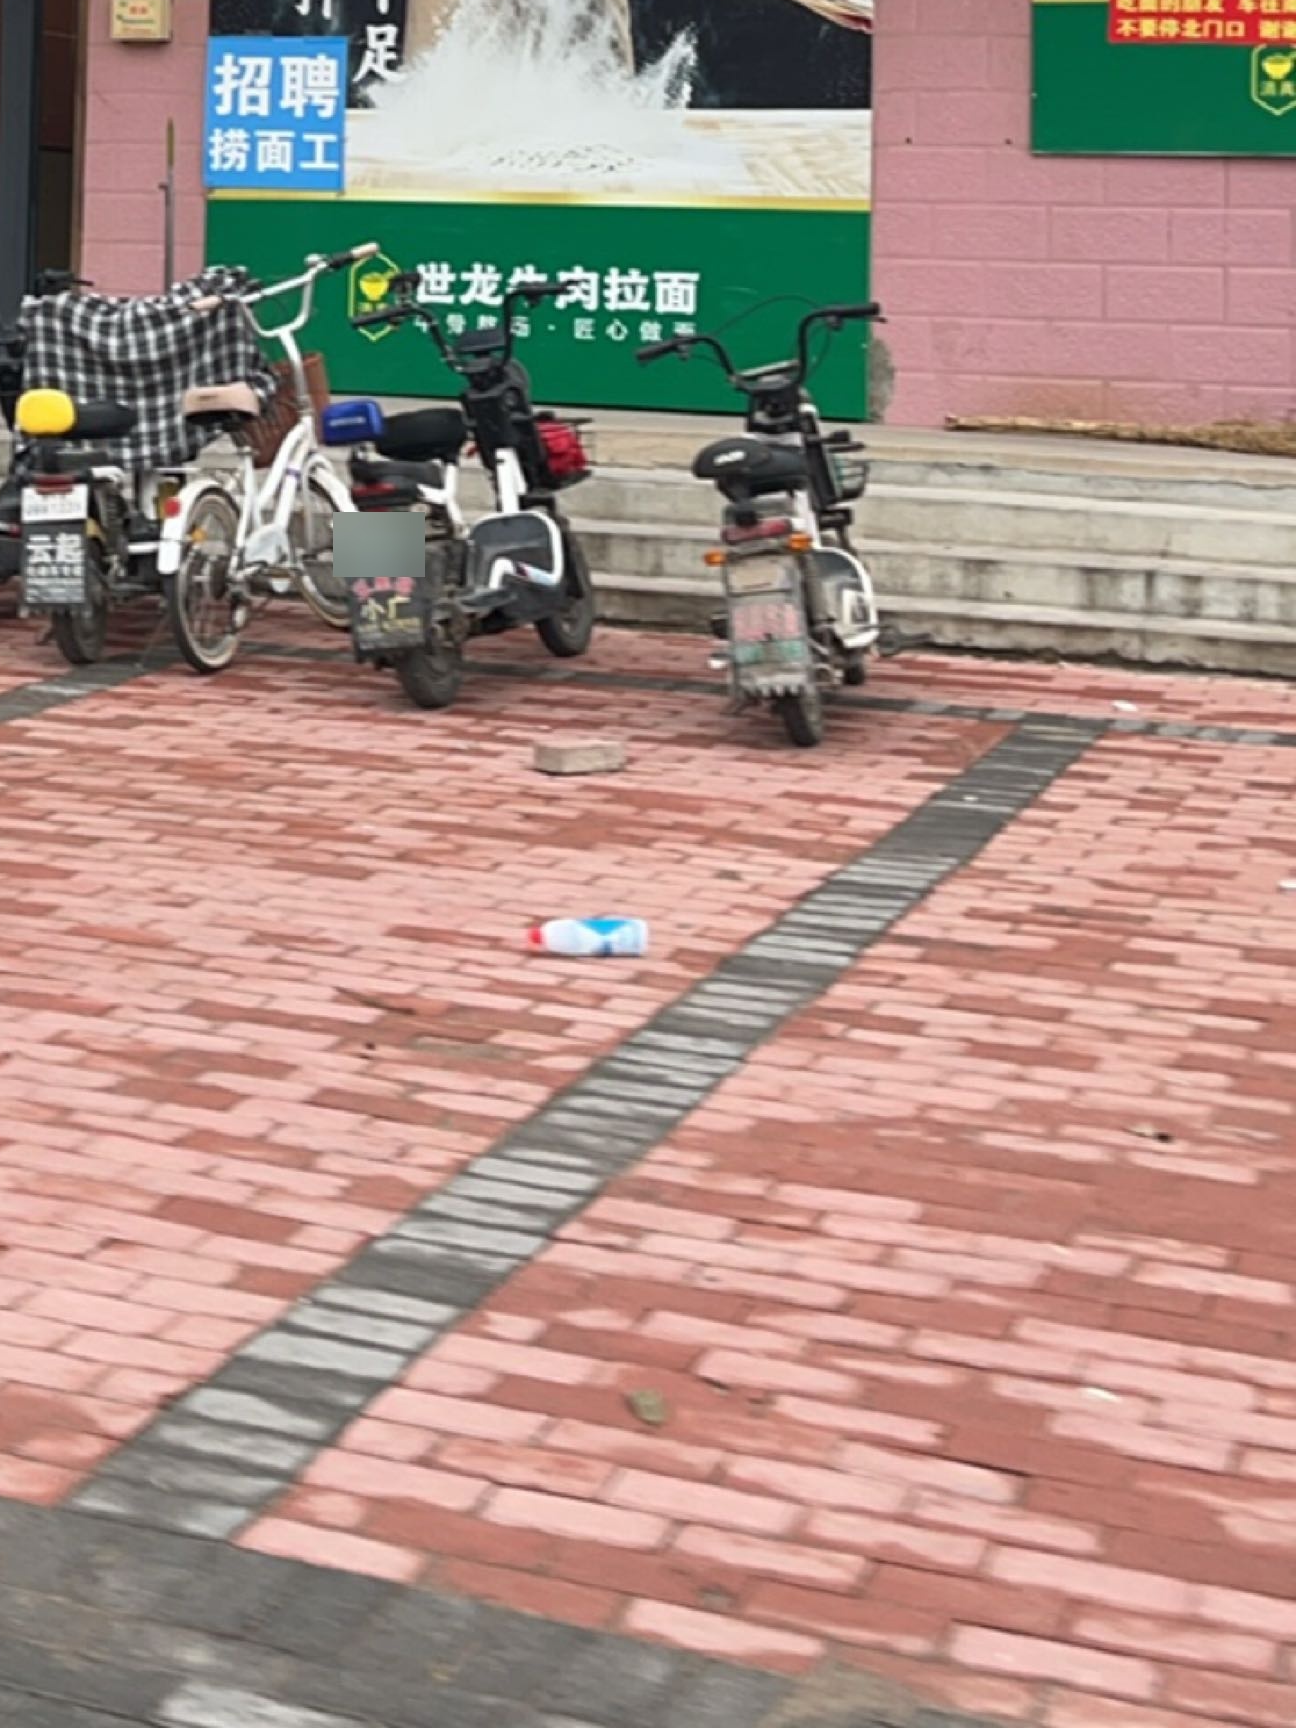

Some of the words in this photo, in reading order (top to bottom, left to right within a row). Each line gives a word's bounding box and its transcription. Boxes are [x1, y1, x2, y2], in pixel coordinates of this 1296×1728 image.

[214, 54, 340, 119] 招聘
[209, 129, 340, 173] 捞面工
